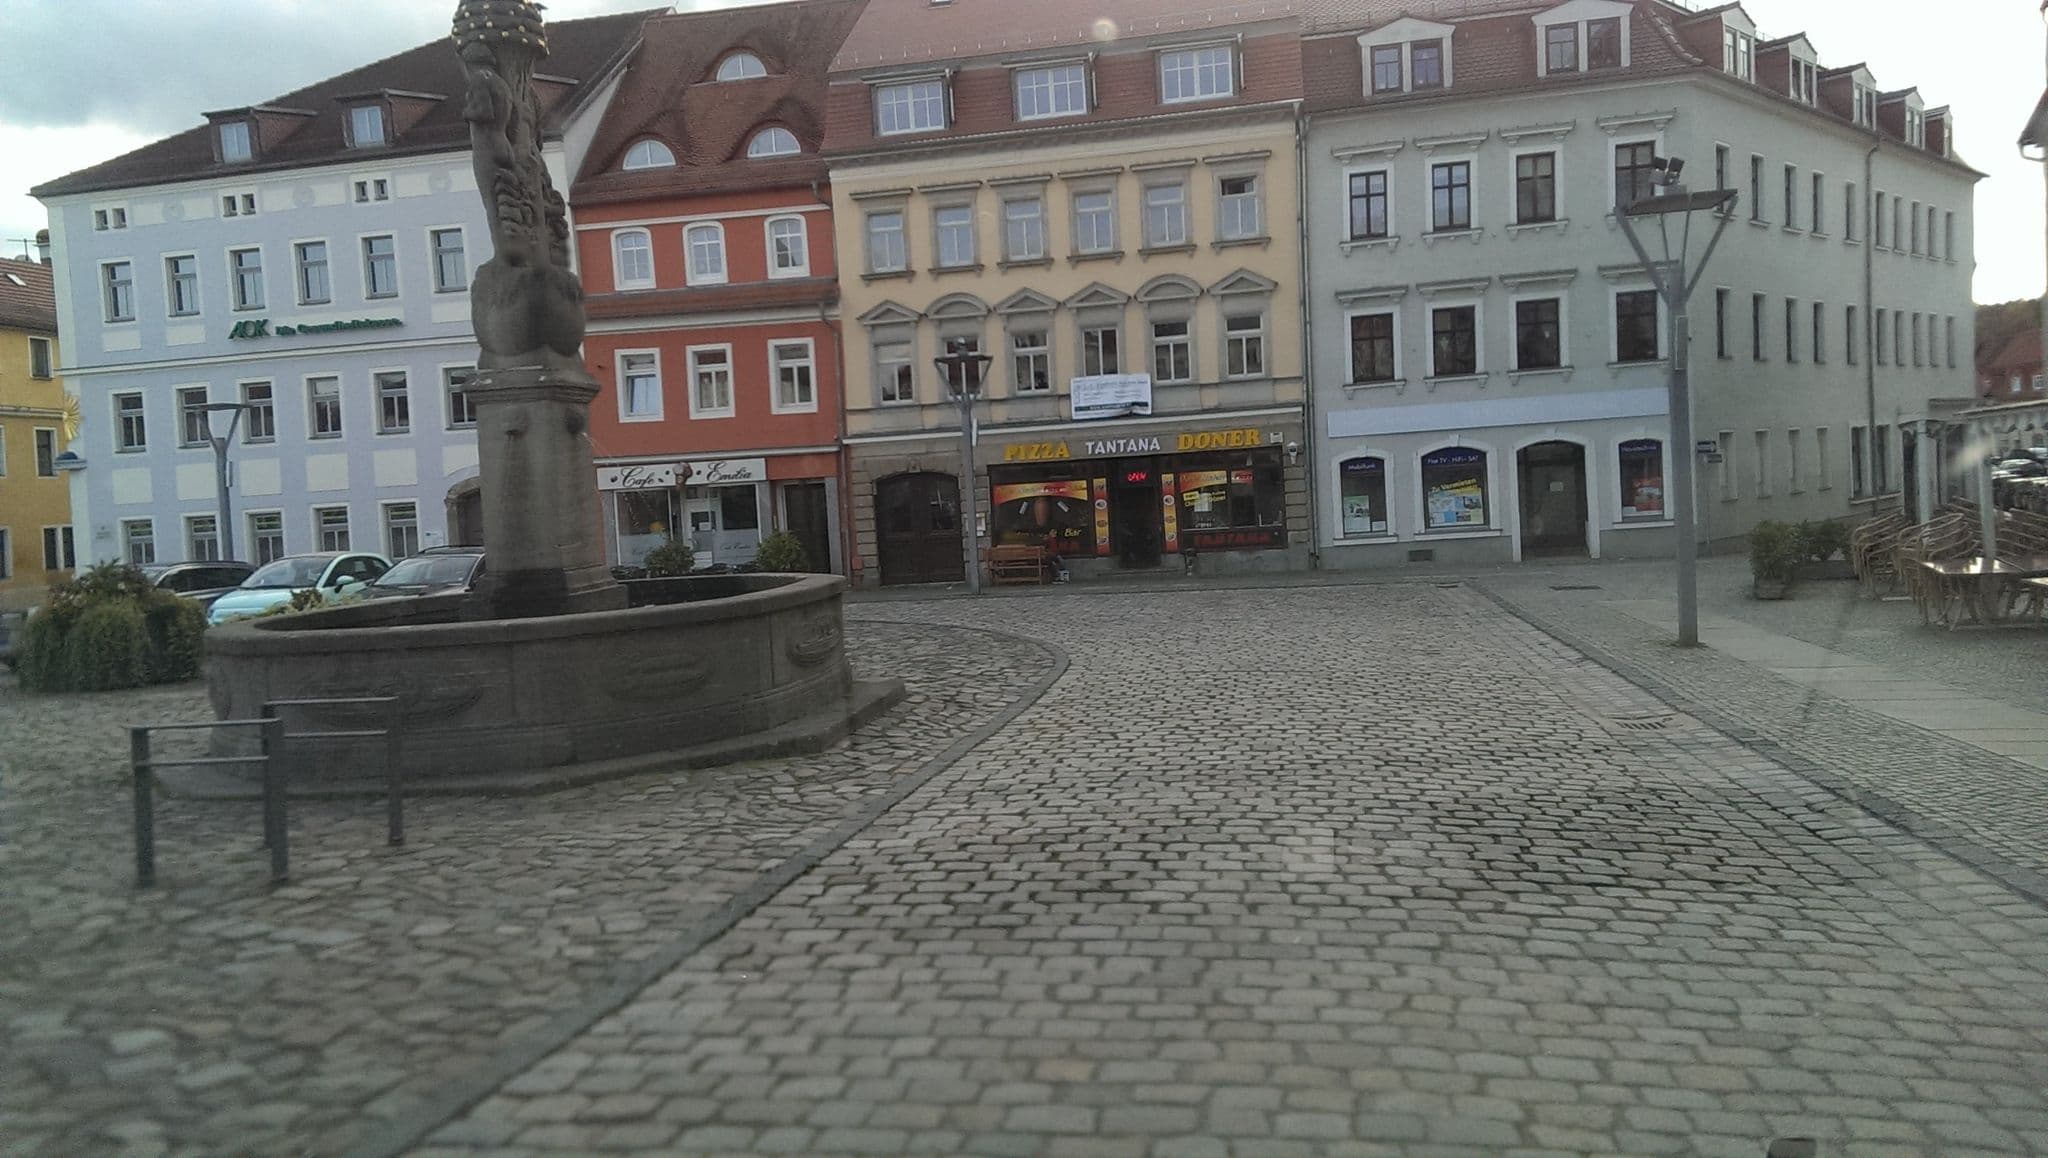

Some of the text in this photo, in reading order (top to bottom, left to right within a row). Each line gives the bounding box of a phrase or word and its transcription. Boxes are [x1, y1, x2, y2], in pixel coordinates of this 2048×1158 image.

[228, 319, 270, 339] AOK
[1004, 441, 1071, 461] PIZZA
[1085, 437, 1161, 455] TANTANA
[706, 461, 751, 482] Emilia
